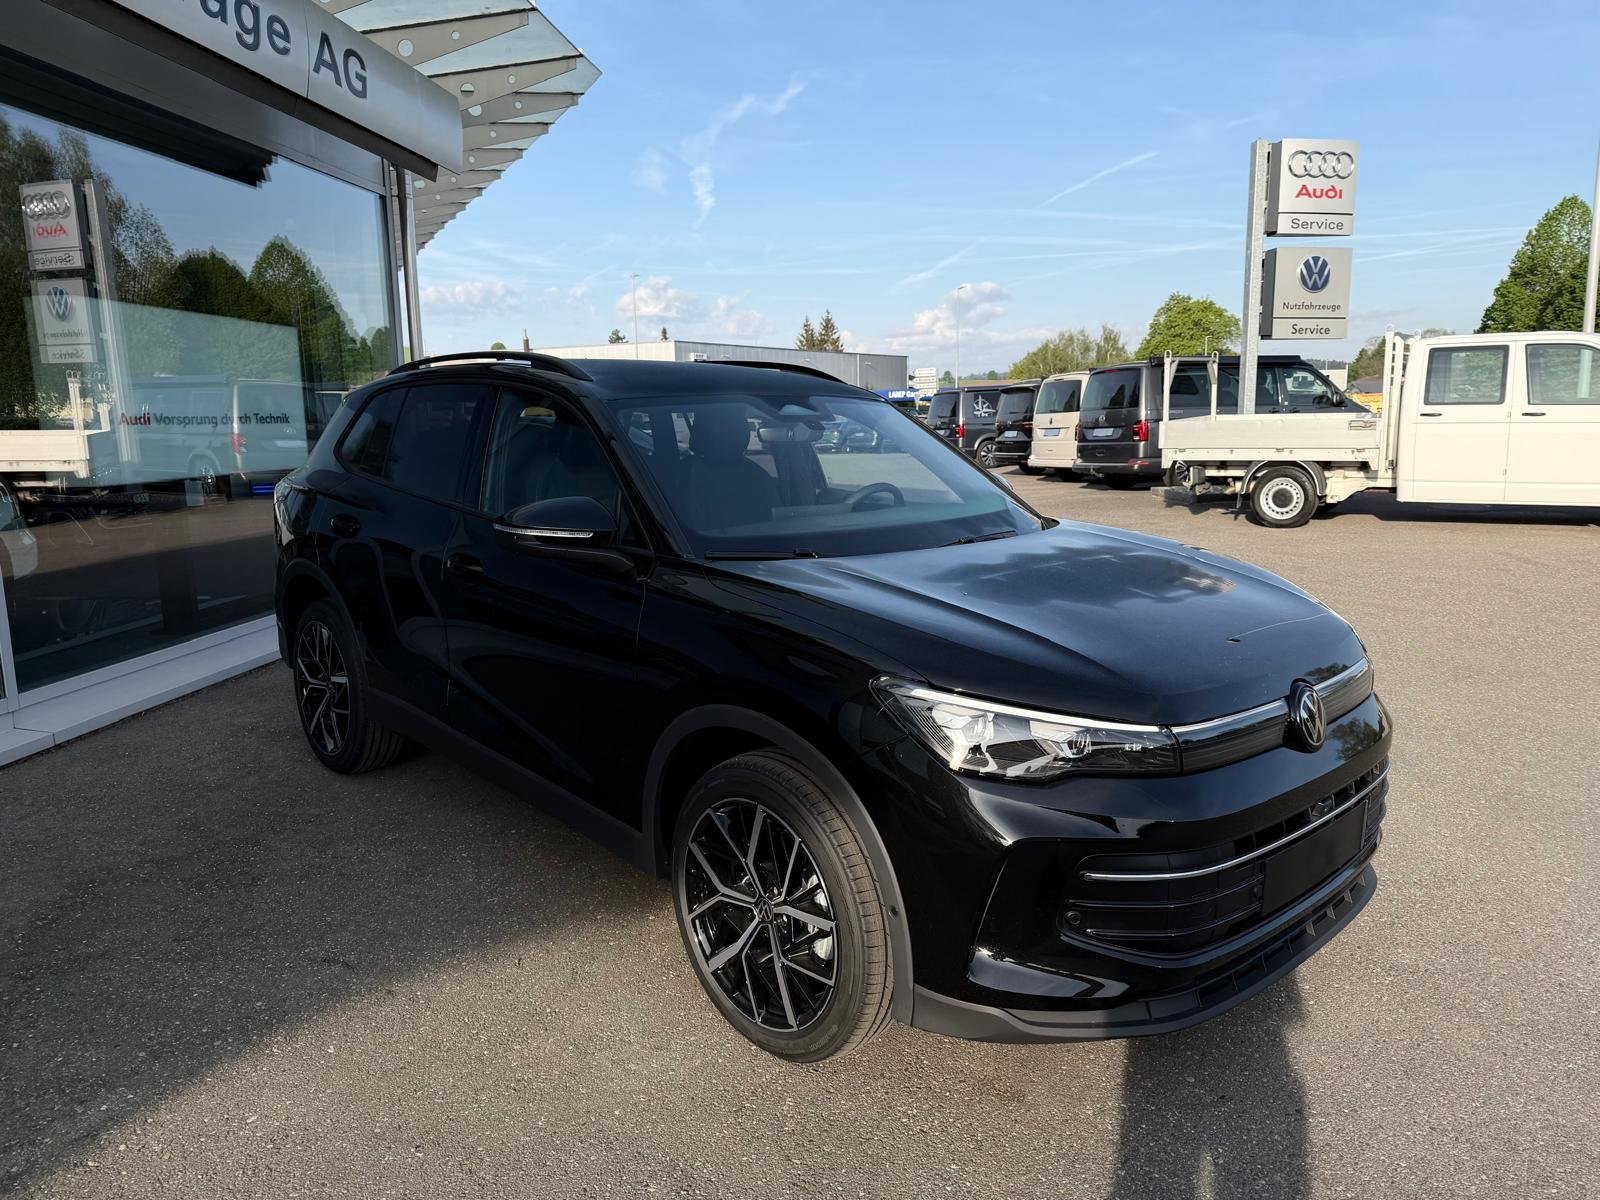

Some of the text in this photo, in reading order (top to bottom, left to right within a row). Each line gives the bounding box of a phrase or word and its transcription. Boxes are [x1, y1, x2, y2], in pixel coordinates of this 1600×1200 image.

[183, 0, 367, 99] age AG
[1295, 184, 1343, 199] Audi
[1290, 218, 1344, 231] Service
[1282, 302, 1341, 312] Nutzfahrzeuge
[1291, 324, 1331, 335] Service
[119, 412, 151, 425] Audi
[153, 412, 218, 428] Vorsprung
[252, 412, 290, 425] Technik
